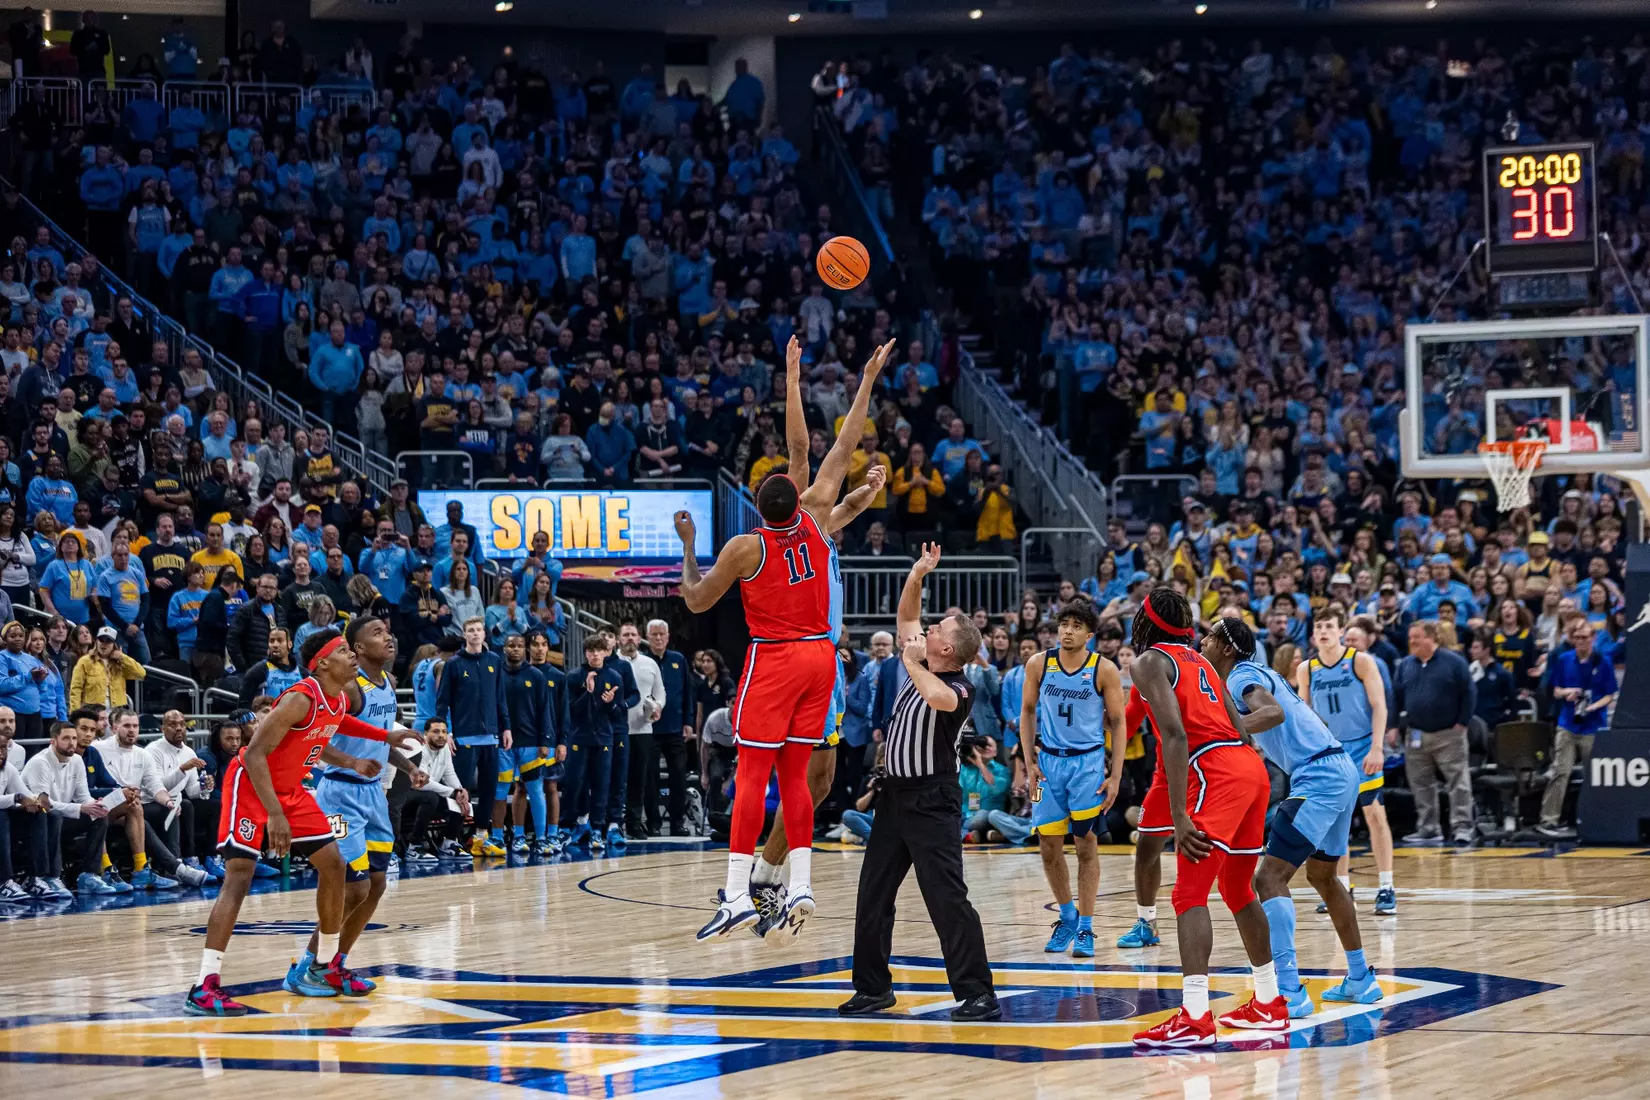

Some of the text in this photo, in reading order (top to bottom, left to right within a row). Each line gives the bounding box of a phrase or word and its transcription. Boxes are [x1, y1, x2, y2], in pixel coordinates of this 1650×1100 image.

[1500, 153, 1581, 188] 20:00
[1512, 186, 1574, 240] 30
[826, 263, 851, 285] ELITE
[490, 494, 632, 553] SOME
[783, 542, 816, 586] 11
[417, 672, 428, 691] 2
[1044, 683, 1093, 701] Marquette
[1198, 667, 1219, 702] 4
[1057, 702, 1074, 727] 4
[1326, 693, 1342, 715] 11
[302, 744, 323, 767] 2
[238, 817, 257, 842] SJ
